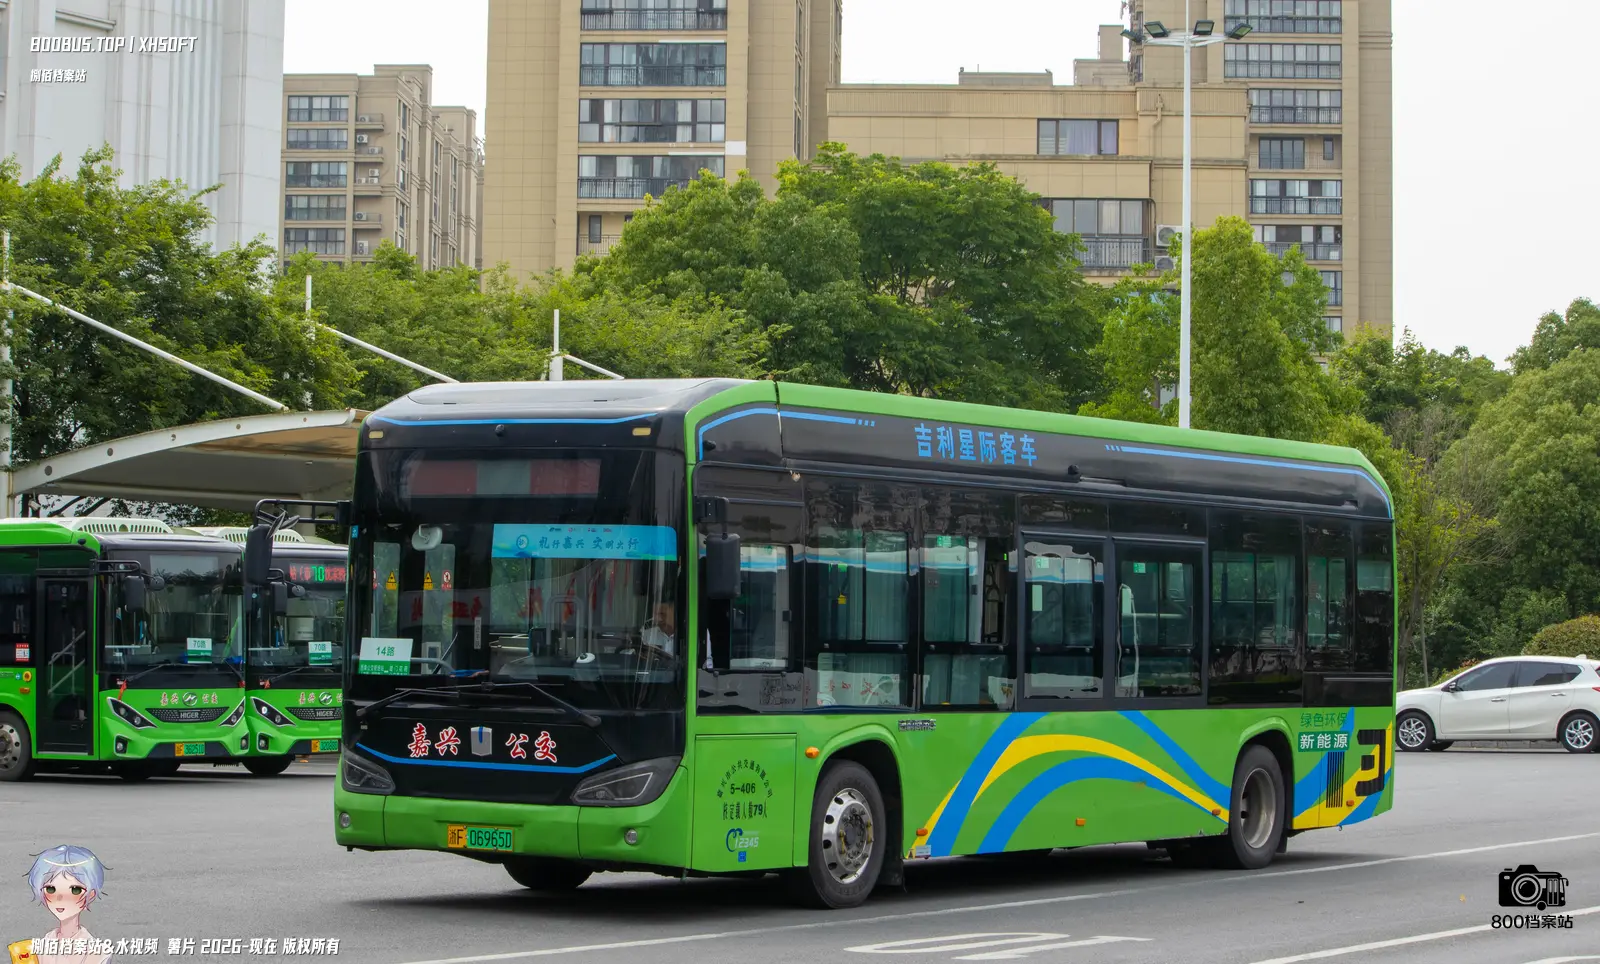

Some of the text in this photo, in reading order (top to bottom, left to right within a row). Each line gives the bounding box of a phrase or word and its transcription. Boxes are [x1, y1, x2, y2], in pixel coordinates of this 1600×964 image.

[914, 423, 1038, 466] 吉利星际客车
[312, 565, 325, 582] 70
[376, 646, 395, 657] 14路
[180, 711, 199, 719] HIGER
[1300, 712, 1348, 728] 绿色环保
[408, 722, 557, 763] 嘉兴 公交
[1299, 733, 1349, 750] 新能源
[730, 782, 756, 795] 5-406
[469, 829, 512, 848] 06965D
[735, 837, 759, 849] 12345
